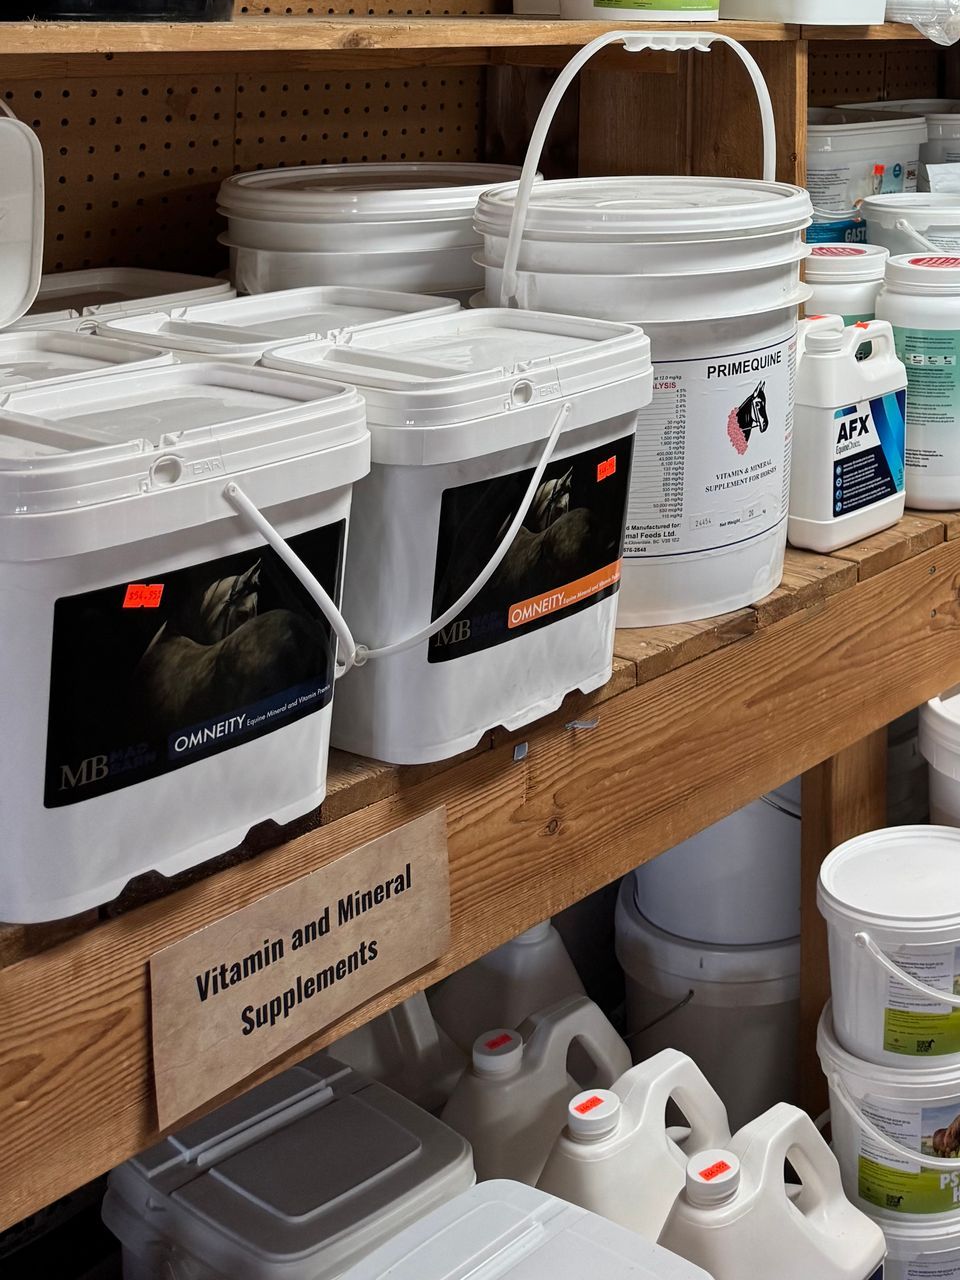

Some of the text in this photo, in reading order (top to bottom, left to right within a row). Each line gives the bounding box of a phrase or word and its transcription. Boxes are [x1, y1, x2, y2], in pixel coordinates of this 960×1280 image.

[707, 350, 782, 379] PRIMEQUINE
[836, 414, 870, 444] AFX
[705, 466, 777, 493] SUPPLEMENT FOR HORSES
[716, 469, 744, 480] VITAMIN
[750, 458, 772, 472] MINERAL
[664, 530, 676, 538] Ltd.
[511, 591, 565, 624] OMNEITY
[434, 620, 471, 648] MB
[174, 713, 246, 752] OMNEITY
[246, 714, 266, 727] Equine
[266, 704, 288, 719] Mineral
[288, 698, 298, 710] and
[298, 692, 317, 704] Vitamin
[58, 755, 110, 792] MB
[196, 863, 412, 1002] Vitamin and Mineral
[241, 939, 379, 1037] Supplements
